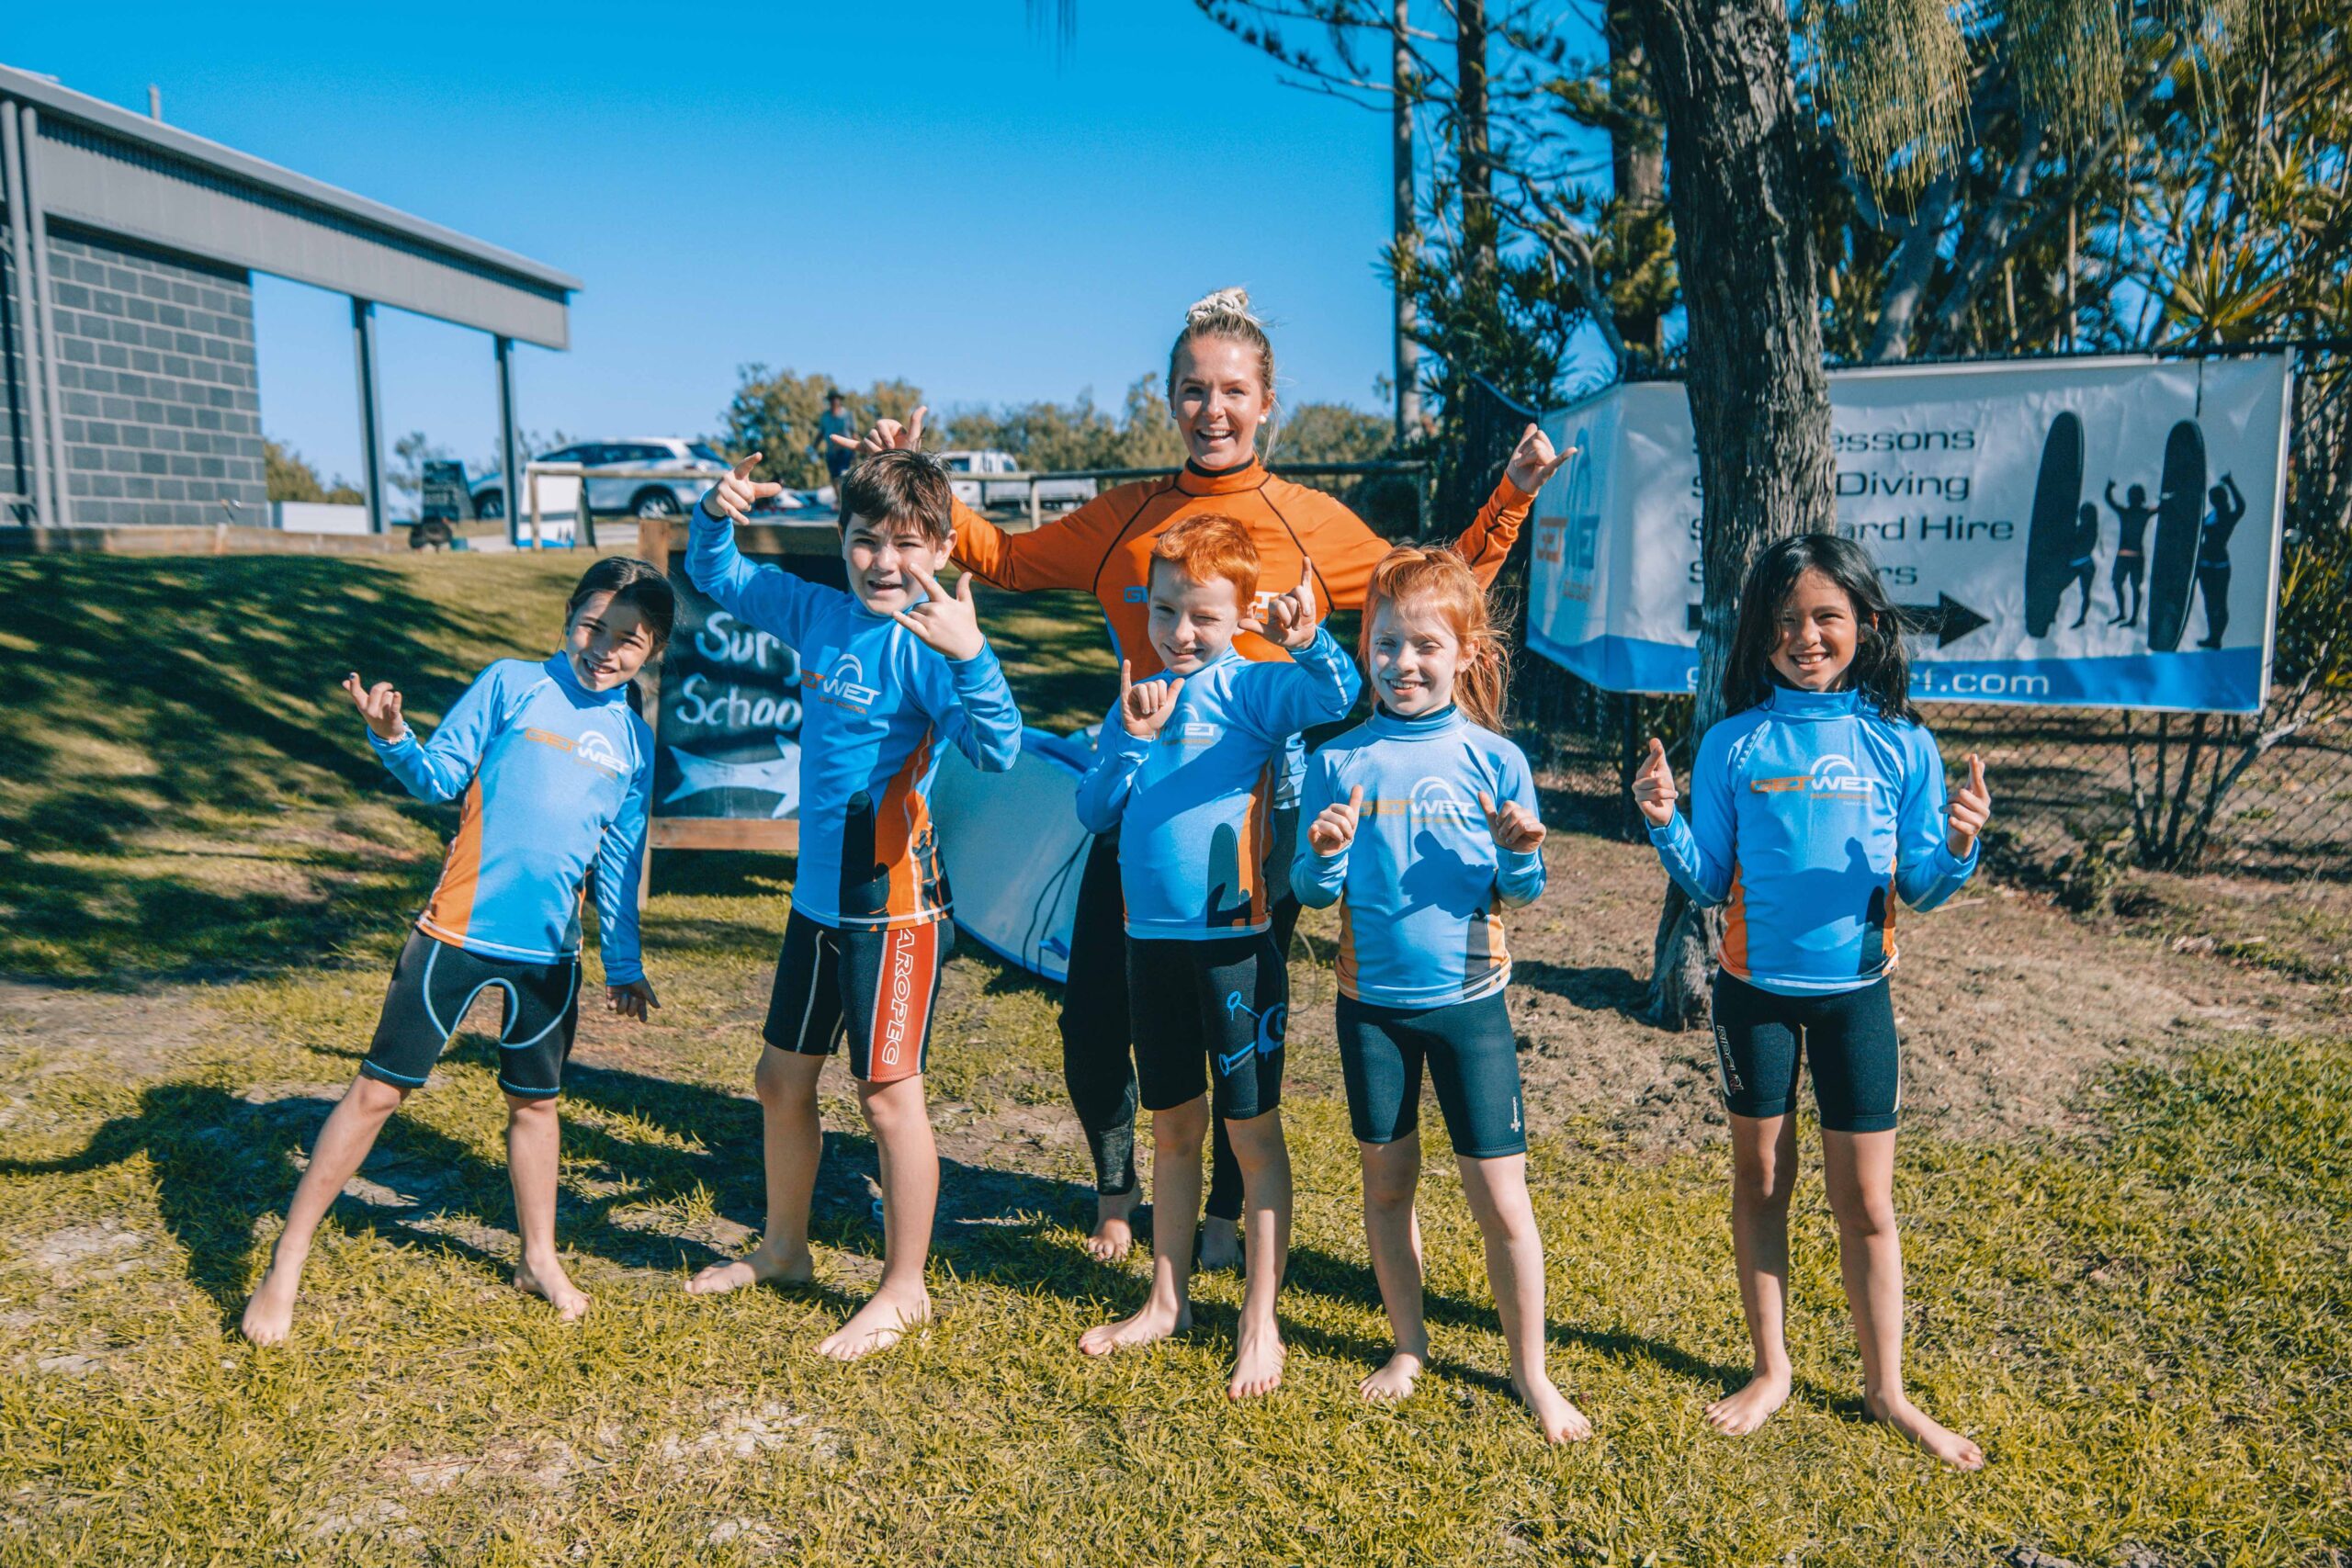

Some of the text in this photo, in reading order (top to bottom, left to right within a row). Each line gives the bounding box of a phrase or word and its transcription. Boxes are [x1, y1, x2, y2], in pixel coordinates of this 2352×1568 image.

[1837, 471, 1971, 502] Diving
[1921, 515, 2014, 540] Hire
[675, 672, 802, 731] Schoo
[882, 929, 914, 1066] AROPEC
